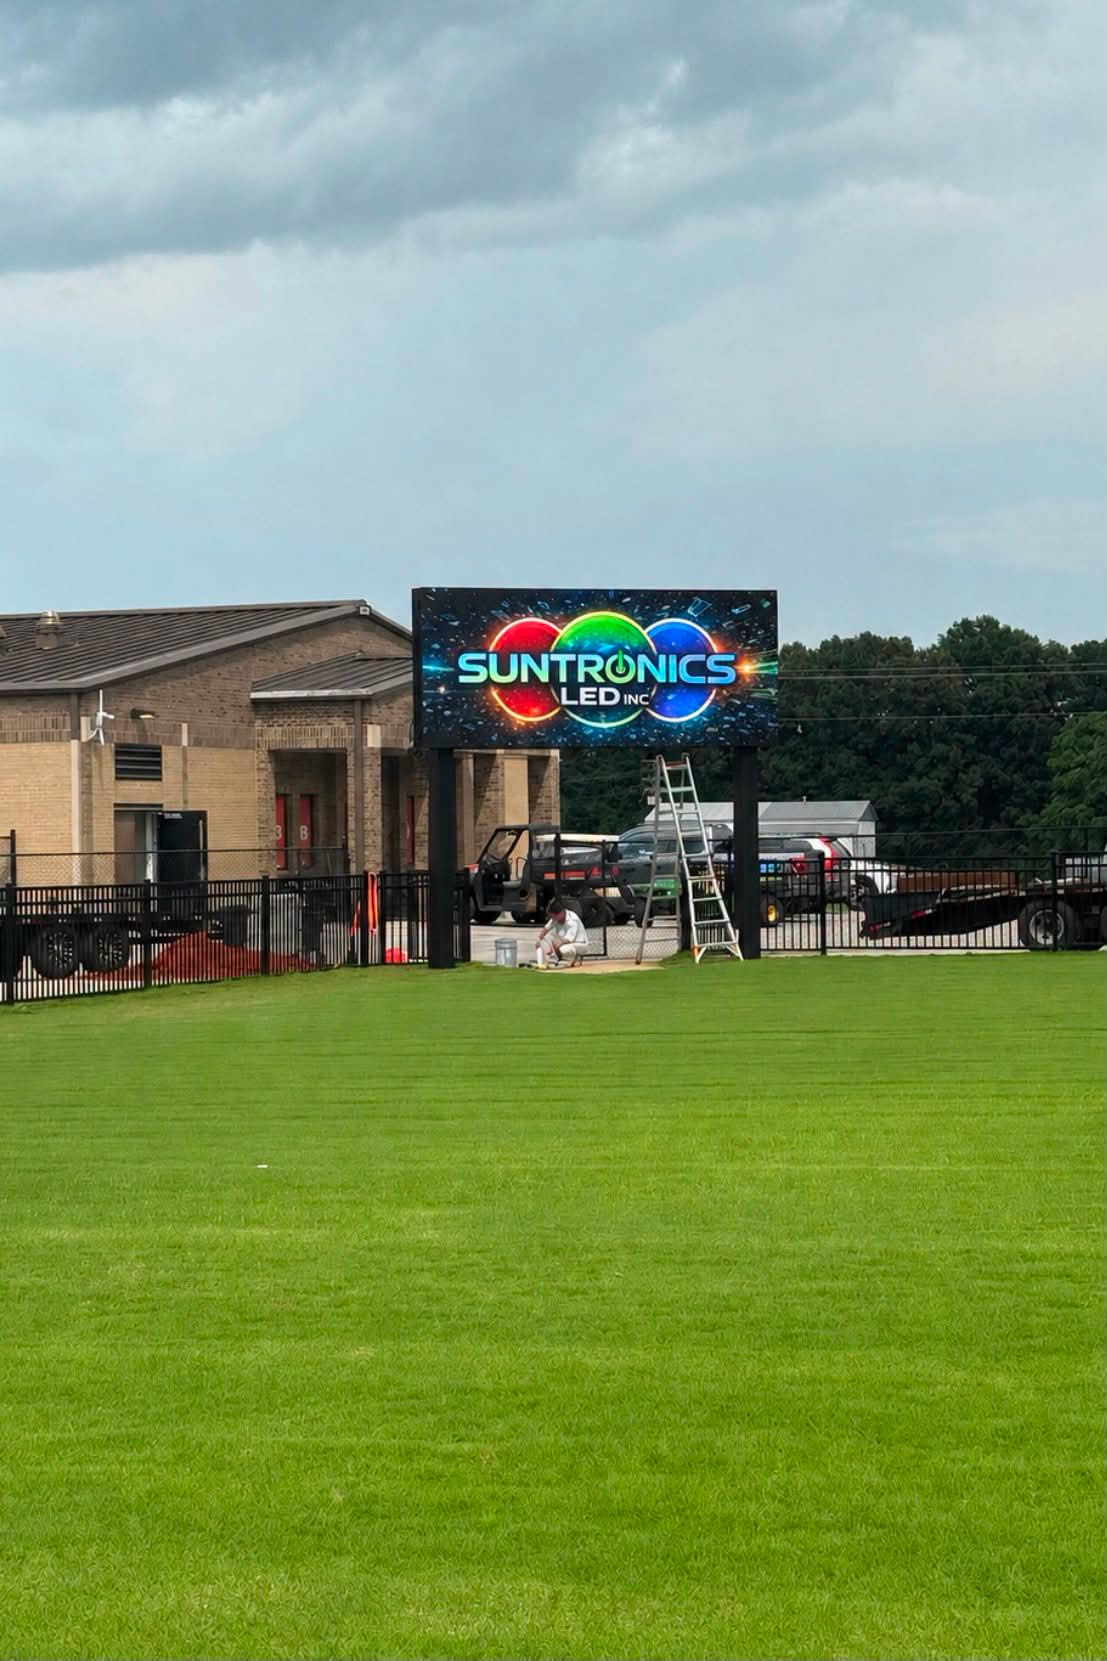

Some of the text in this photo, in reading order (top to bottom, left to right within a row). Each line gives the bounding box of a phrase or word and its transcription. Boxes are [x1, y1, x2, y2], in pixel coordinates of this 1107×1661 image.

[458, 651, 736, 684] SUNTRONICS
[560, 686, 650, 706] LED INC
